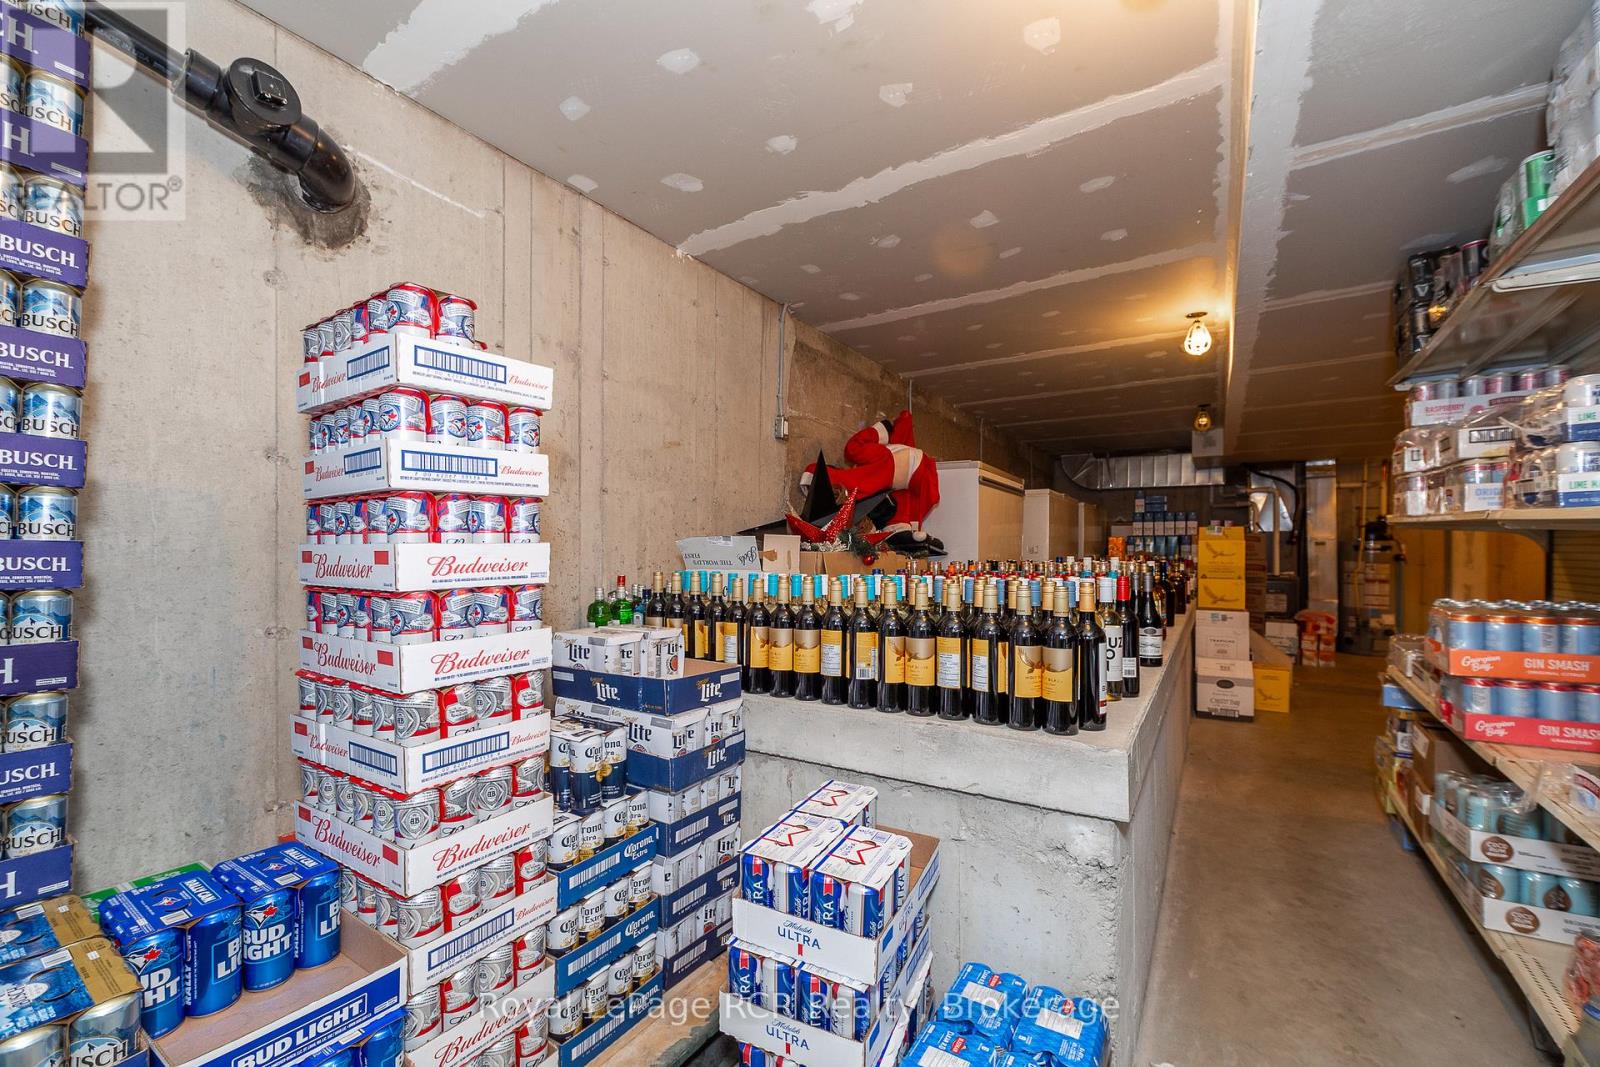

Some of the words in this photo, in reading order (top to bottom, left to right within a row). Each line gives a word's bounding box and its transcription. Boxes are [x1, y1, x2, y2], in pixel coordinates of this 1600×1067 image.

[25, 104, 73, 132] USCH
[24, 209, 82, 237] BUSCH
[0, 234, 79, 268] BUSCH
[22, 312, 80, 337] BUSCH
[508, 374, 549, 391] Budweiser
[22, 417, 80, 438] BUSCH
[0, 448, 78, 471] BUSCH
[499, 464, 543, 478] Budweiser
[315, 463, 346, 483] Budweiser
[18, 522, 76, 538] BUSCH
[313, 552, 374, 579] Budweiser
[427, 554, 529, 577] Budweiser
[11, 624, 62, 640] USCH
[313, 641, 377, 677] Budweiser
[431, 647, 531, 676] Budweiser
[568, 643, 591, 662] Lite
[1523, 657, 1545, 669] GIN
[1547, 658, 1590, 672] SMASH
[596, 682, 618, 702] Lite
[701, 682, 722, 702] Lite
[511, 729, 549, 747] Budweiser
[626, 721, 652, 744] Lite
[1538, 724, 1560, 737] GIN
[706, 748, 726, 770] Lite
[0, 762, 59, 786] USCH
[312, 815, 382, 868] Budweiser
[433, 822, 531, 872] Budweiser
[624, 836, 654, 858] Corona
[632, 848, 648, 861] Extra
[515, 896, 555, 921] Budweiser
[243, 923, 285, 945] BUD
[625, 910, 656, 937] Corona
[633, 924, 650, 939] Extra
[243, 932, 292, 960] IGHT
[777, 926, 821, 950] ULTRA
[237, 1036, 293, 1067] BUD
[296, 999, 363, 1046] LIGHT
[434, 996, 534, 1067] Budweiser
[766, 1025, 810, 1051] ULTRA
